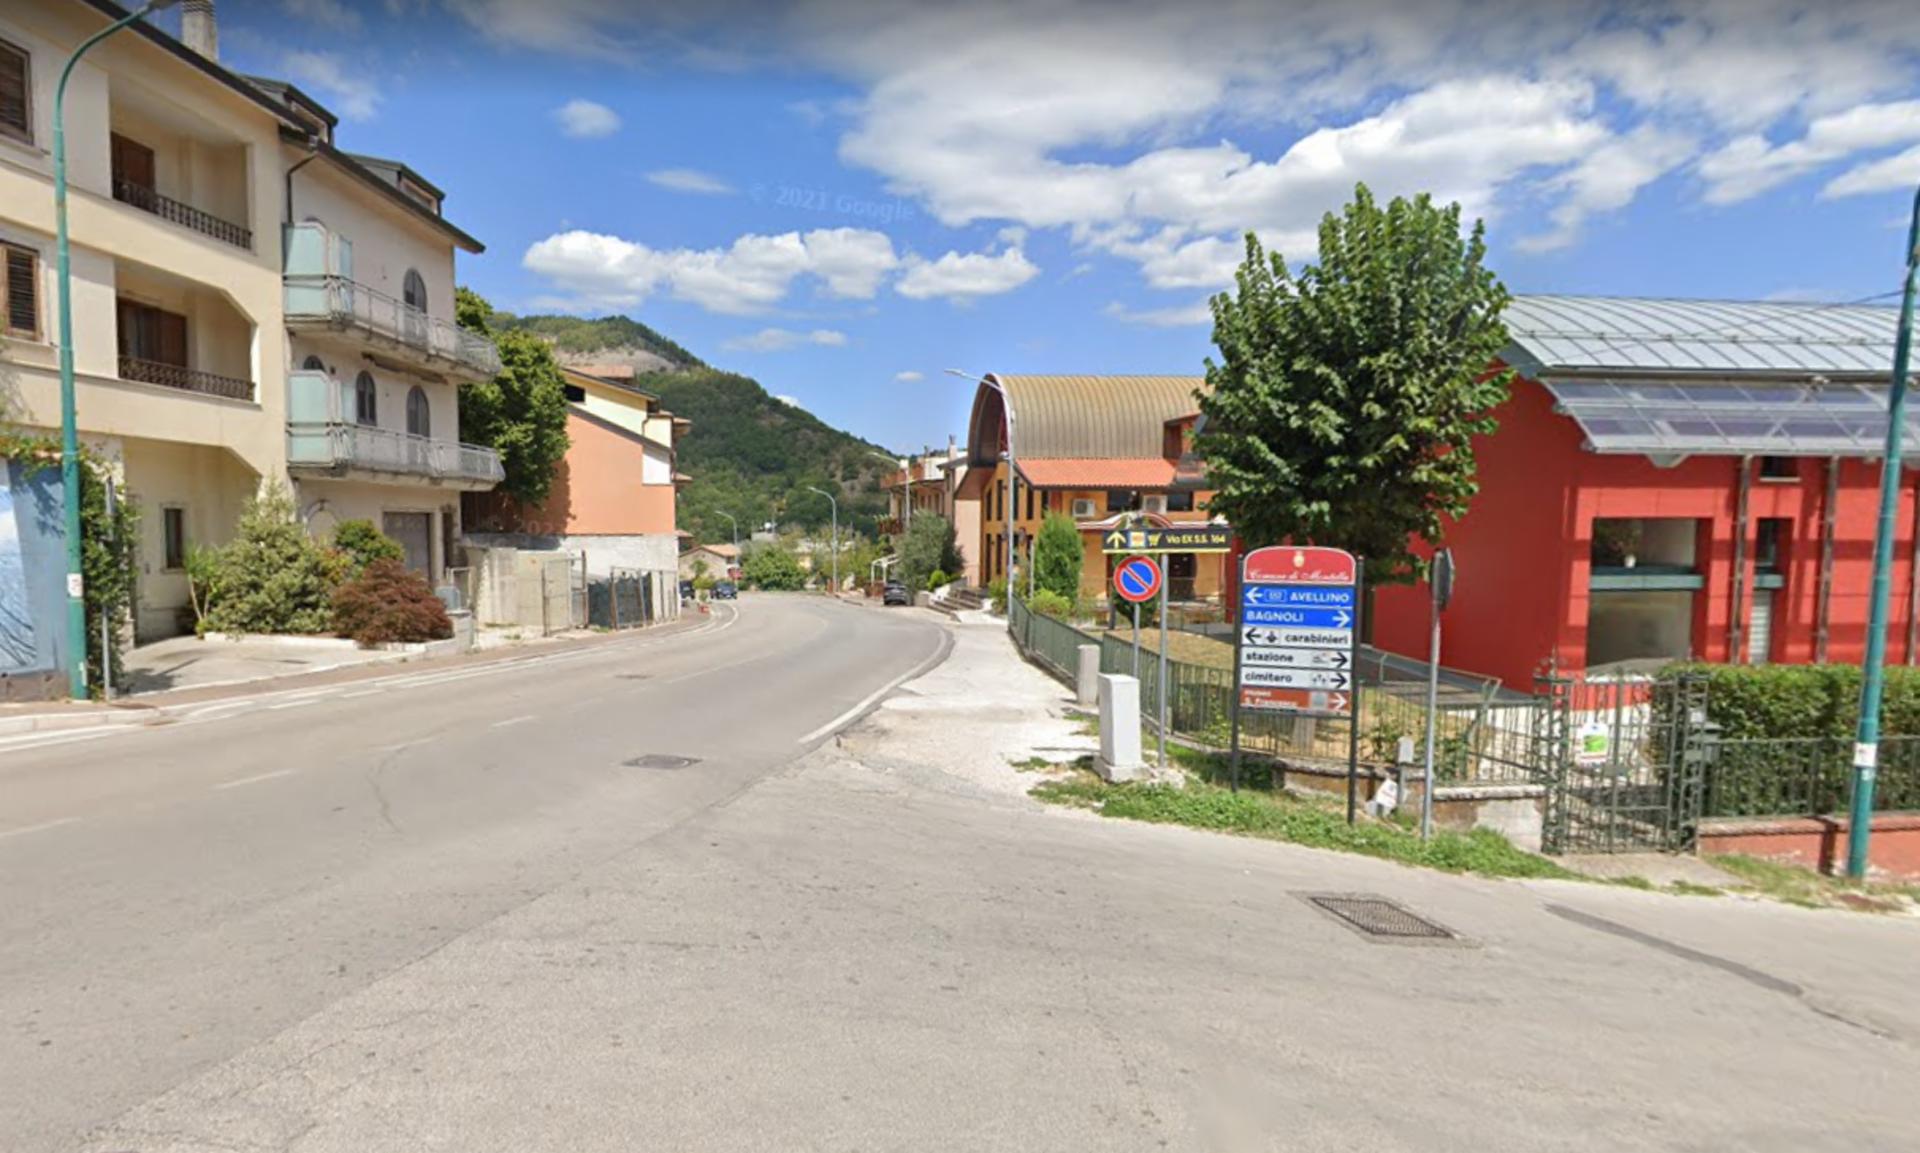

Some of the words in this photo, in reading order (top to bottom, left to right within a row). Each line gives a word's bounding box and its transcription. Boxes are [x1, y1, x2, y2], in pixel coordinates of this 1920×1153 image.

[1290, 591, 1350, 604] AVELLINO
[1246, 610, 1305, 623] BAGNOLI
[1284, 633, 1349, 645] carabinieri
[1246, 651, 1294, 663] stazione
[1244, 672, 1293, 683] cimitero
